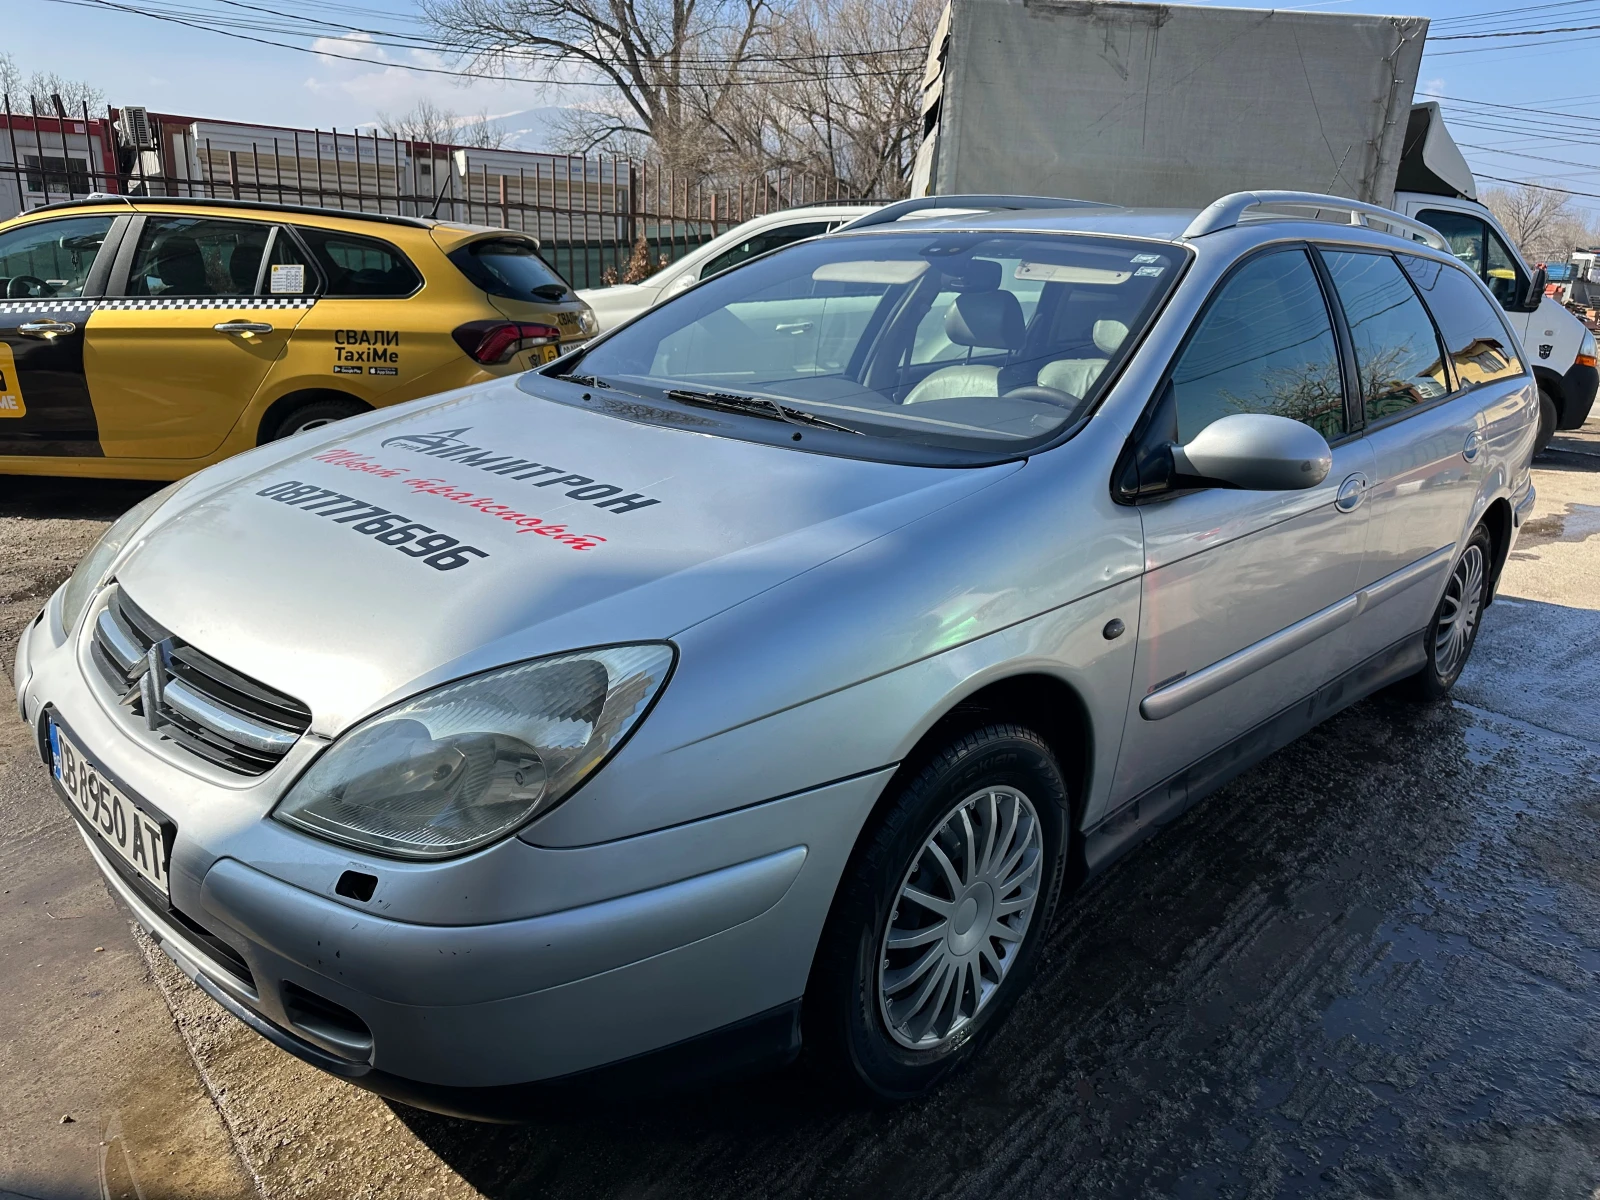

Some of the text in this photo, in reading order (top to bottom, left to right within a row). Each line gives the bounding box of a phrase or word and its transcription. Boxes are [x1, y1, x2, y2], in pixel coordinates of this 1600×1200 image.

[334, 329, 399, 347] СВАЛИ
[334, 346, 399, 363] TaxiMe
[255, 480, 491, 572] 0877776696
[79, 760, 127, 849] 8950
[132, 811, 161, 881] AT
